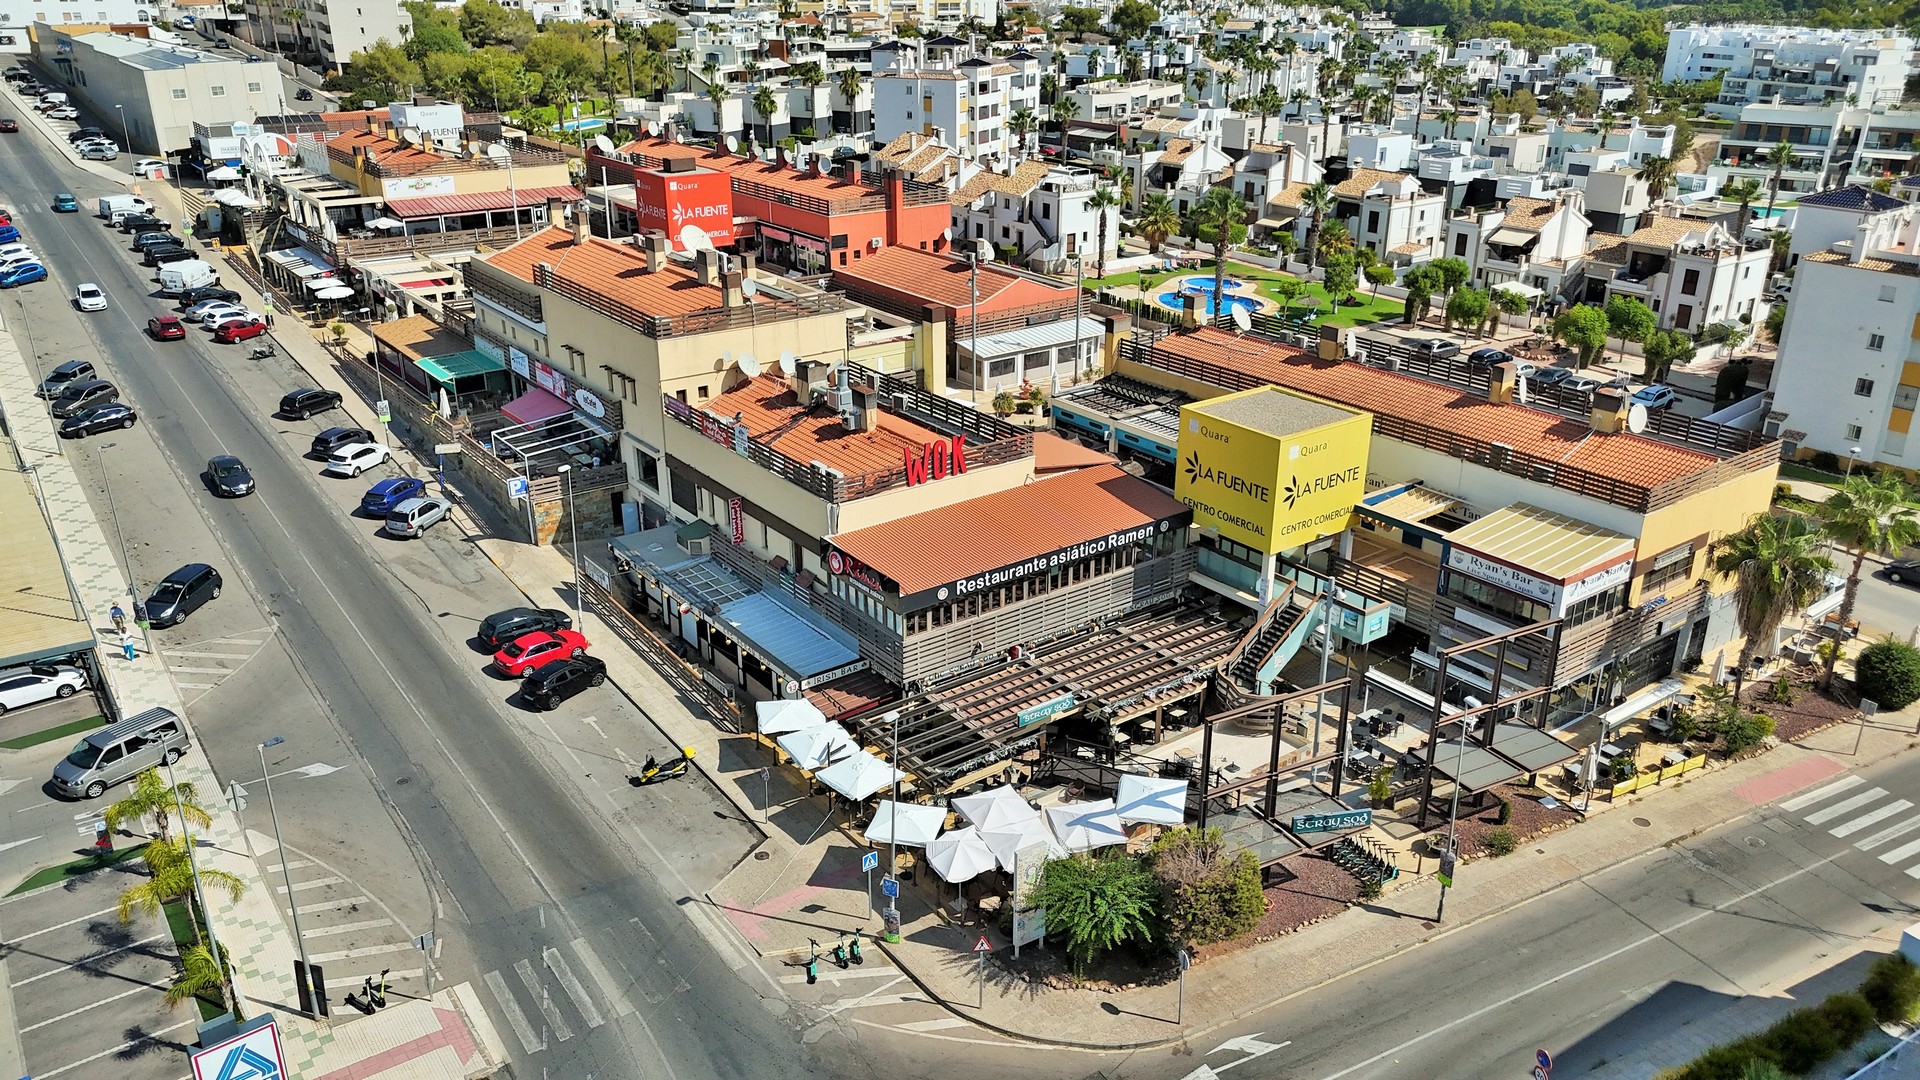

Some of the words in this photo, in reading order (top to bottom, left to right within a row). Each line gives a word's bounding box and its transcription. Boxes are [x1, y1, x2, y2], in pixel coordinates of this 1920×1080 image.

[682, 208, 695, 219] LA
[695, 204, 729, 218] FUENTE
[1200, 424, 1230, 444] Quara
[1300, 441, 1329, 458] Quara
[904, 434, 968, 487] WOK
[511, 480, 522, 495] P
[1199, 464, 1215, 482] LA
[1216, 469, 1270, 503] FUENTE
[1296, 481, 1313, 499] LA
[1313, 465, 1360, 491] FUENTE
[1182, 495, 1215, 514] CENTRO
[1216, 508, 1266, 538] COMERCIAL
[1280, 518, 1312, 537] CENTRO
[1313, 504, 1355, 528] COMERCIAL
[956, 558, 1048, 596] Restaurante
[1049, 540, 1106, 567] asiático
[1107, 525, 1155, 549] Ramen
[1470, 556, 1509, 578] Ryan's
[1511, 572, 1534, 586] Bar
[1466, 565, 1480, 575] Live
[1481, 572, 1504, 586] Sports
[1513, 583, 1534, 595] Tapas
